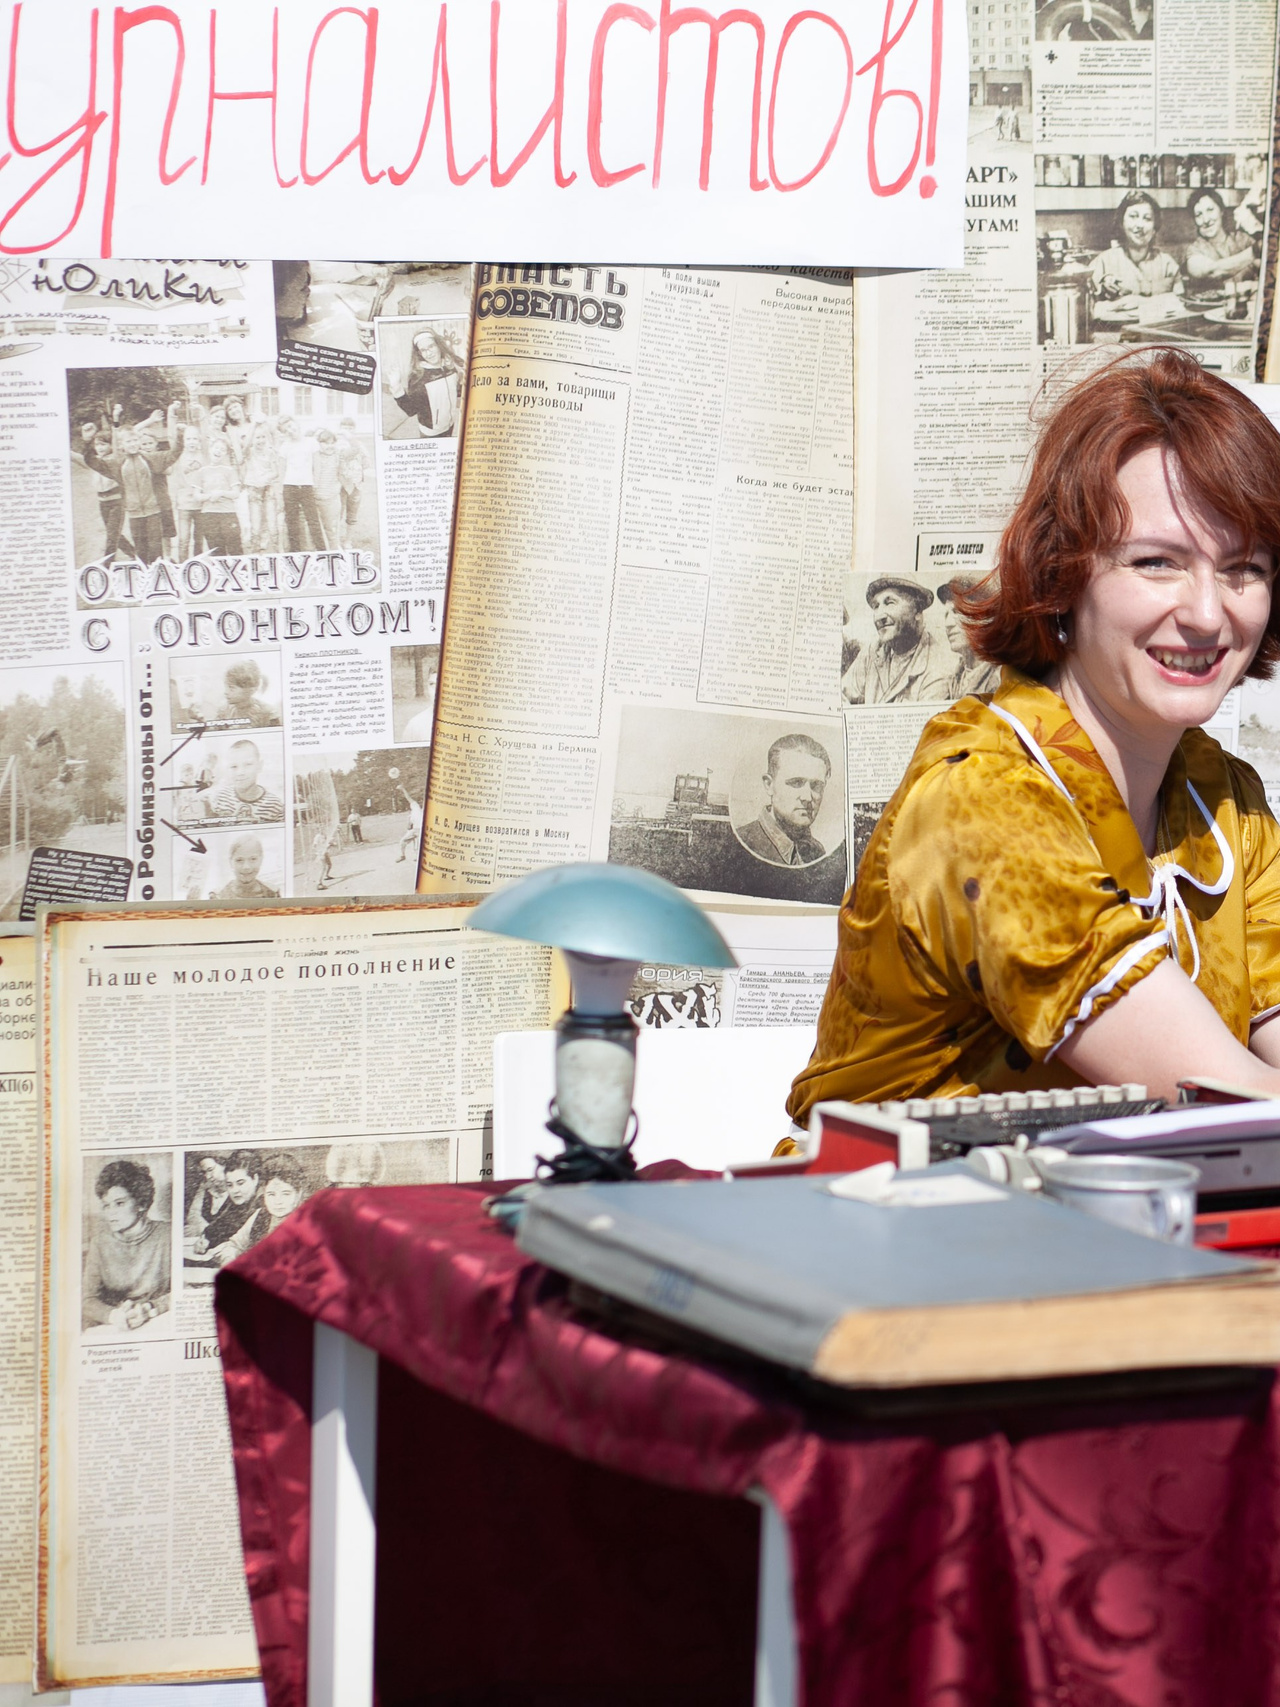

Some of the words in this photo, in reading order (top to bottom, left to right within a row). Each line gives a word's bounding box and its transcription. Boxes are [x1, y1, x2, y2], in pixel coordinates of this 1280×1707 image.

[0, 0, 941, 259] урналистов!
[964, 219, 1018, 232] УГАМ!
[761, 297, 813, 312] передовых
[775, 288, 818, 302] Высокая
[497, 376, 510, 386] за
[516, 376, 549, 391] вами,
[557, 381, 616, 400] товарищи
[496, 393, 584, 412] кукурузоводы
[736, 475, 768, 487] Когда
[773, 480, 788, 490] же
[792, 481, 823, 495] будет
[79, 552, 378, 601] ОТДОХНУТЬ
[82, 619, 111, 653] С
[494, 738, 537, 751] Хрущева
[558, 743, 597, 754] Берлина
[136, 725, 156, 879] Робинзоны
[454, 820, 480, 833] Хрущев
[544, 828, 570, 840] Москву
[87, 968, 157, 987] Наше
[173, 965, 285, 984] молодое
[298, 956, 456, 979] пополнение
[0, 981, 36, 991] иали-
